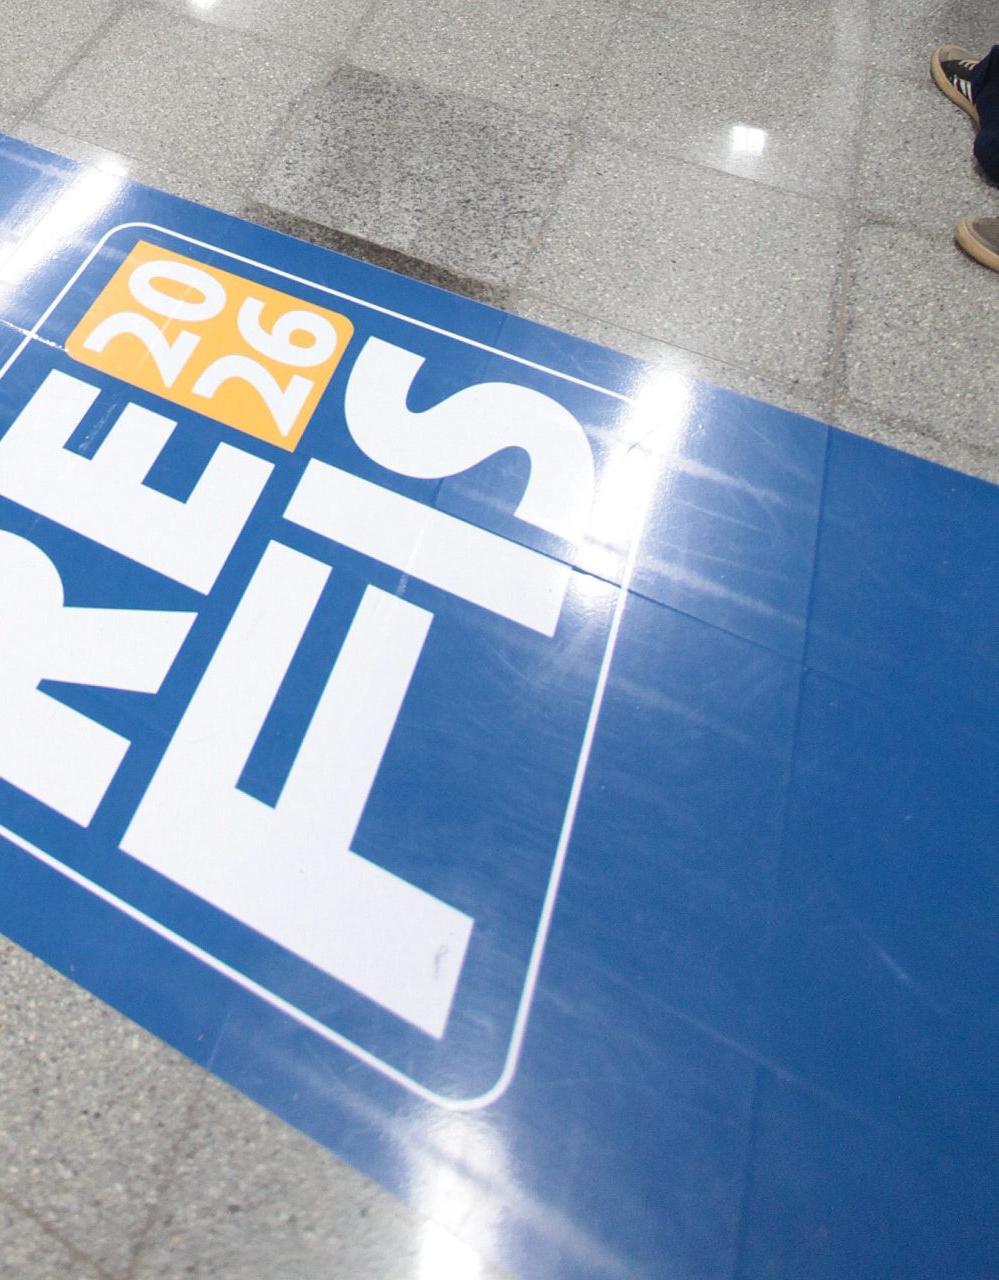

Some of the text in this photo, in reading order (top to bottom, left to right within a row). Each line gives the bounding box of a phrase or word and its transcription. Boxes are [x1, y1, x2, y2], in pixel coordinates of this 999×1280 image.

[82, 258, 228, 388] 20
[192, 299, 338, 438] 26
[118, 335, 596, 1041] FIS
